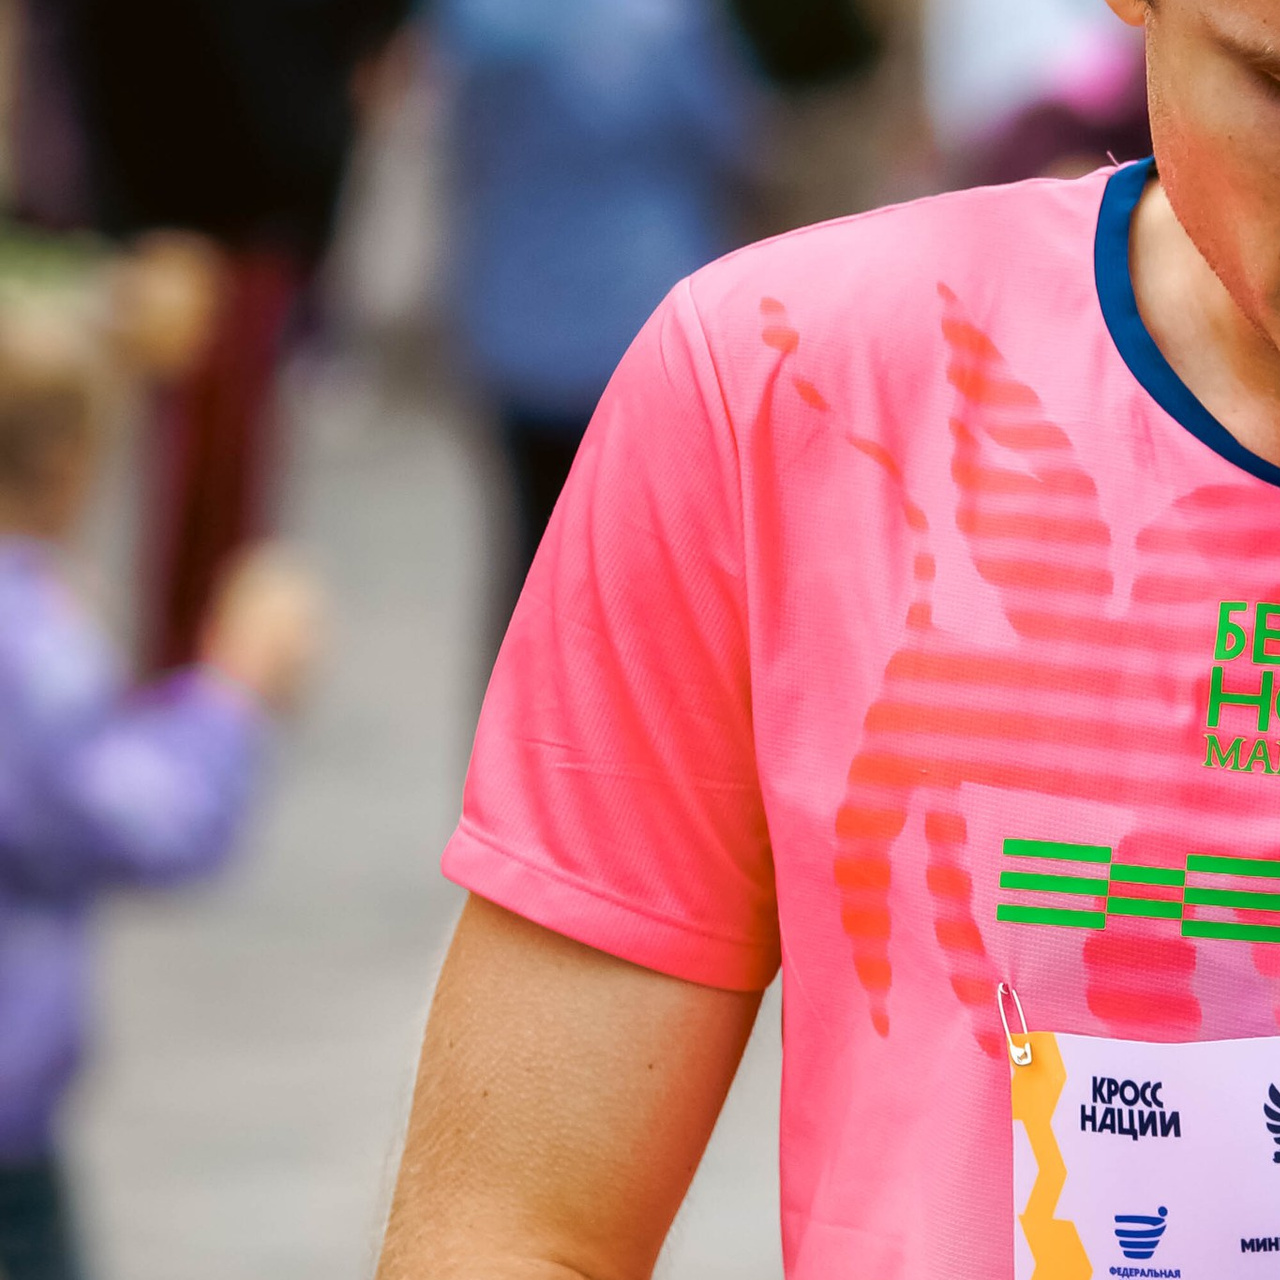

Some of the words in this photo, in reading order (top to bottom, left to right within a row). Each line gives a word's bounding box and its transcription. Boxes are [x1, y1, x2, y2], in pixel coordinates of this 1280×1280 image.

[1092, 1076, 1164, 1109] КРОСС
[1080, 1104, 1181, 1141] НАЦИИ
[1109, 1266, 1181, 1278] ФЕДЕРАЛЬНАЯ
